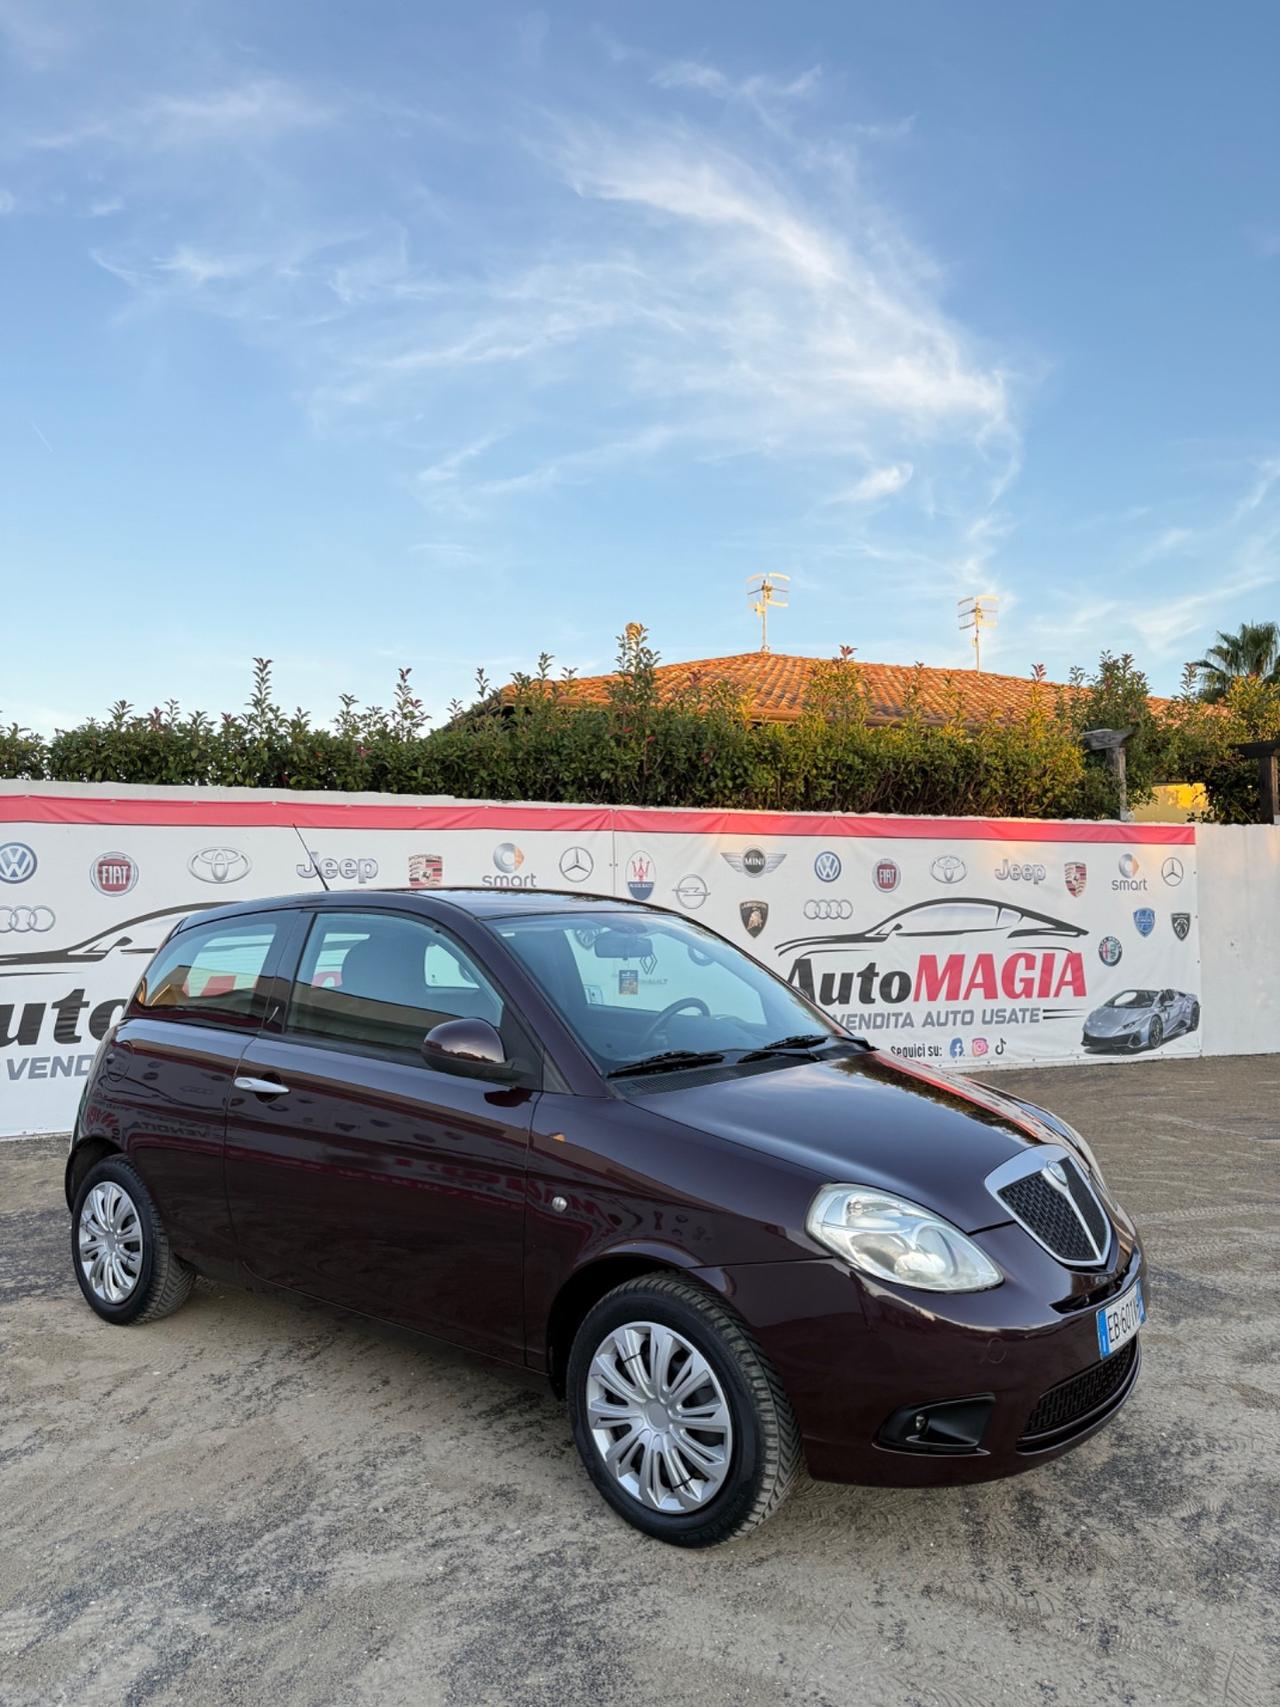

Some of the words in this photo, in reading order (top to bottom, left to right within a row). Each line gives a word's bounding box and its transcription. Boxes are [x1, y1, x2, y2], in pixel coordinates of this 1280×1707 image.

[296, 851, 378, 884] Jeep
[744, 857, 765, 866] MINI
[995, 859, 1046, 885] Jeep
[102, 865, 129, 885] FIAT
[482, 873, 537, 887] smart
[879, 868, 896, 883] FIAT
[1111, 878, 1148, 891] smart
[787, 952, 1087, 1004] AutoMAGIA
[0, 988, 128, 1048] uto
[833, 1012, 914, 1031] VENDITA
[922, 1009, 974, 1028] AUTO
[981, 1007, 1041, 1025] USATE
[6, 1054, 97, 1080] VEND
[1107, 1312, 1120, 1343] EB
